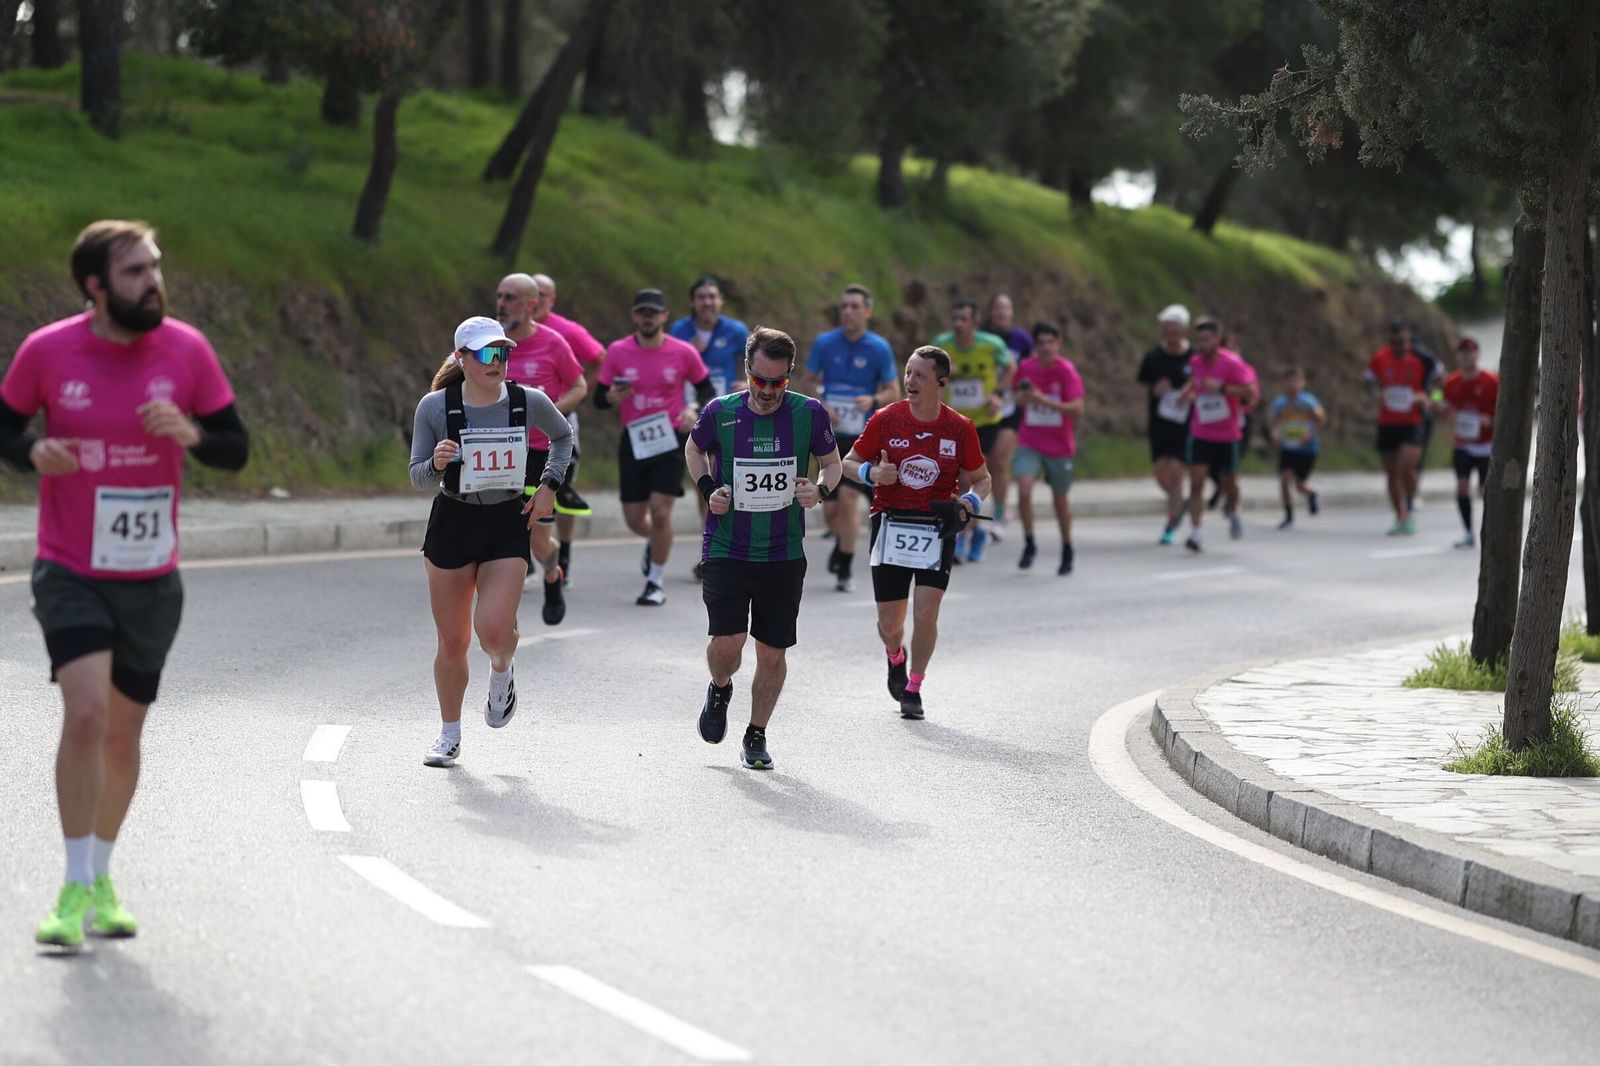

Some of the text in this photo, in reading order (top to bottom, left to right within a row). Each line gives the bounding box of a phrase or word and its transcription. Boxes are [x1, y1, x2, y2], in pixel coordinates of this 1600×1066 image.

[638, 424, 666, 442] 421
[472, 450, 516, 471] 111
[906, 463, 935, 477] PONLE
[745, 472, 788, 492] 348
[903, 468, 930, 482] FRENO
[110, 511, 160, 540] 451
[895, 534, 933, 553] 527
